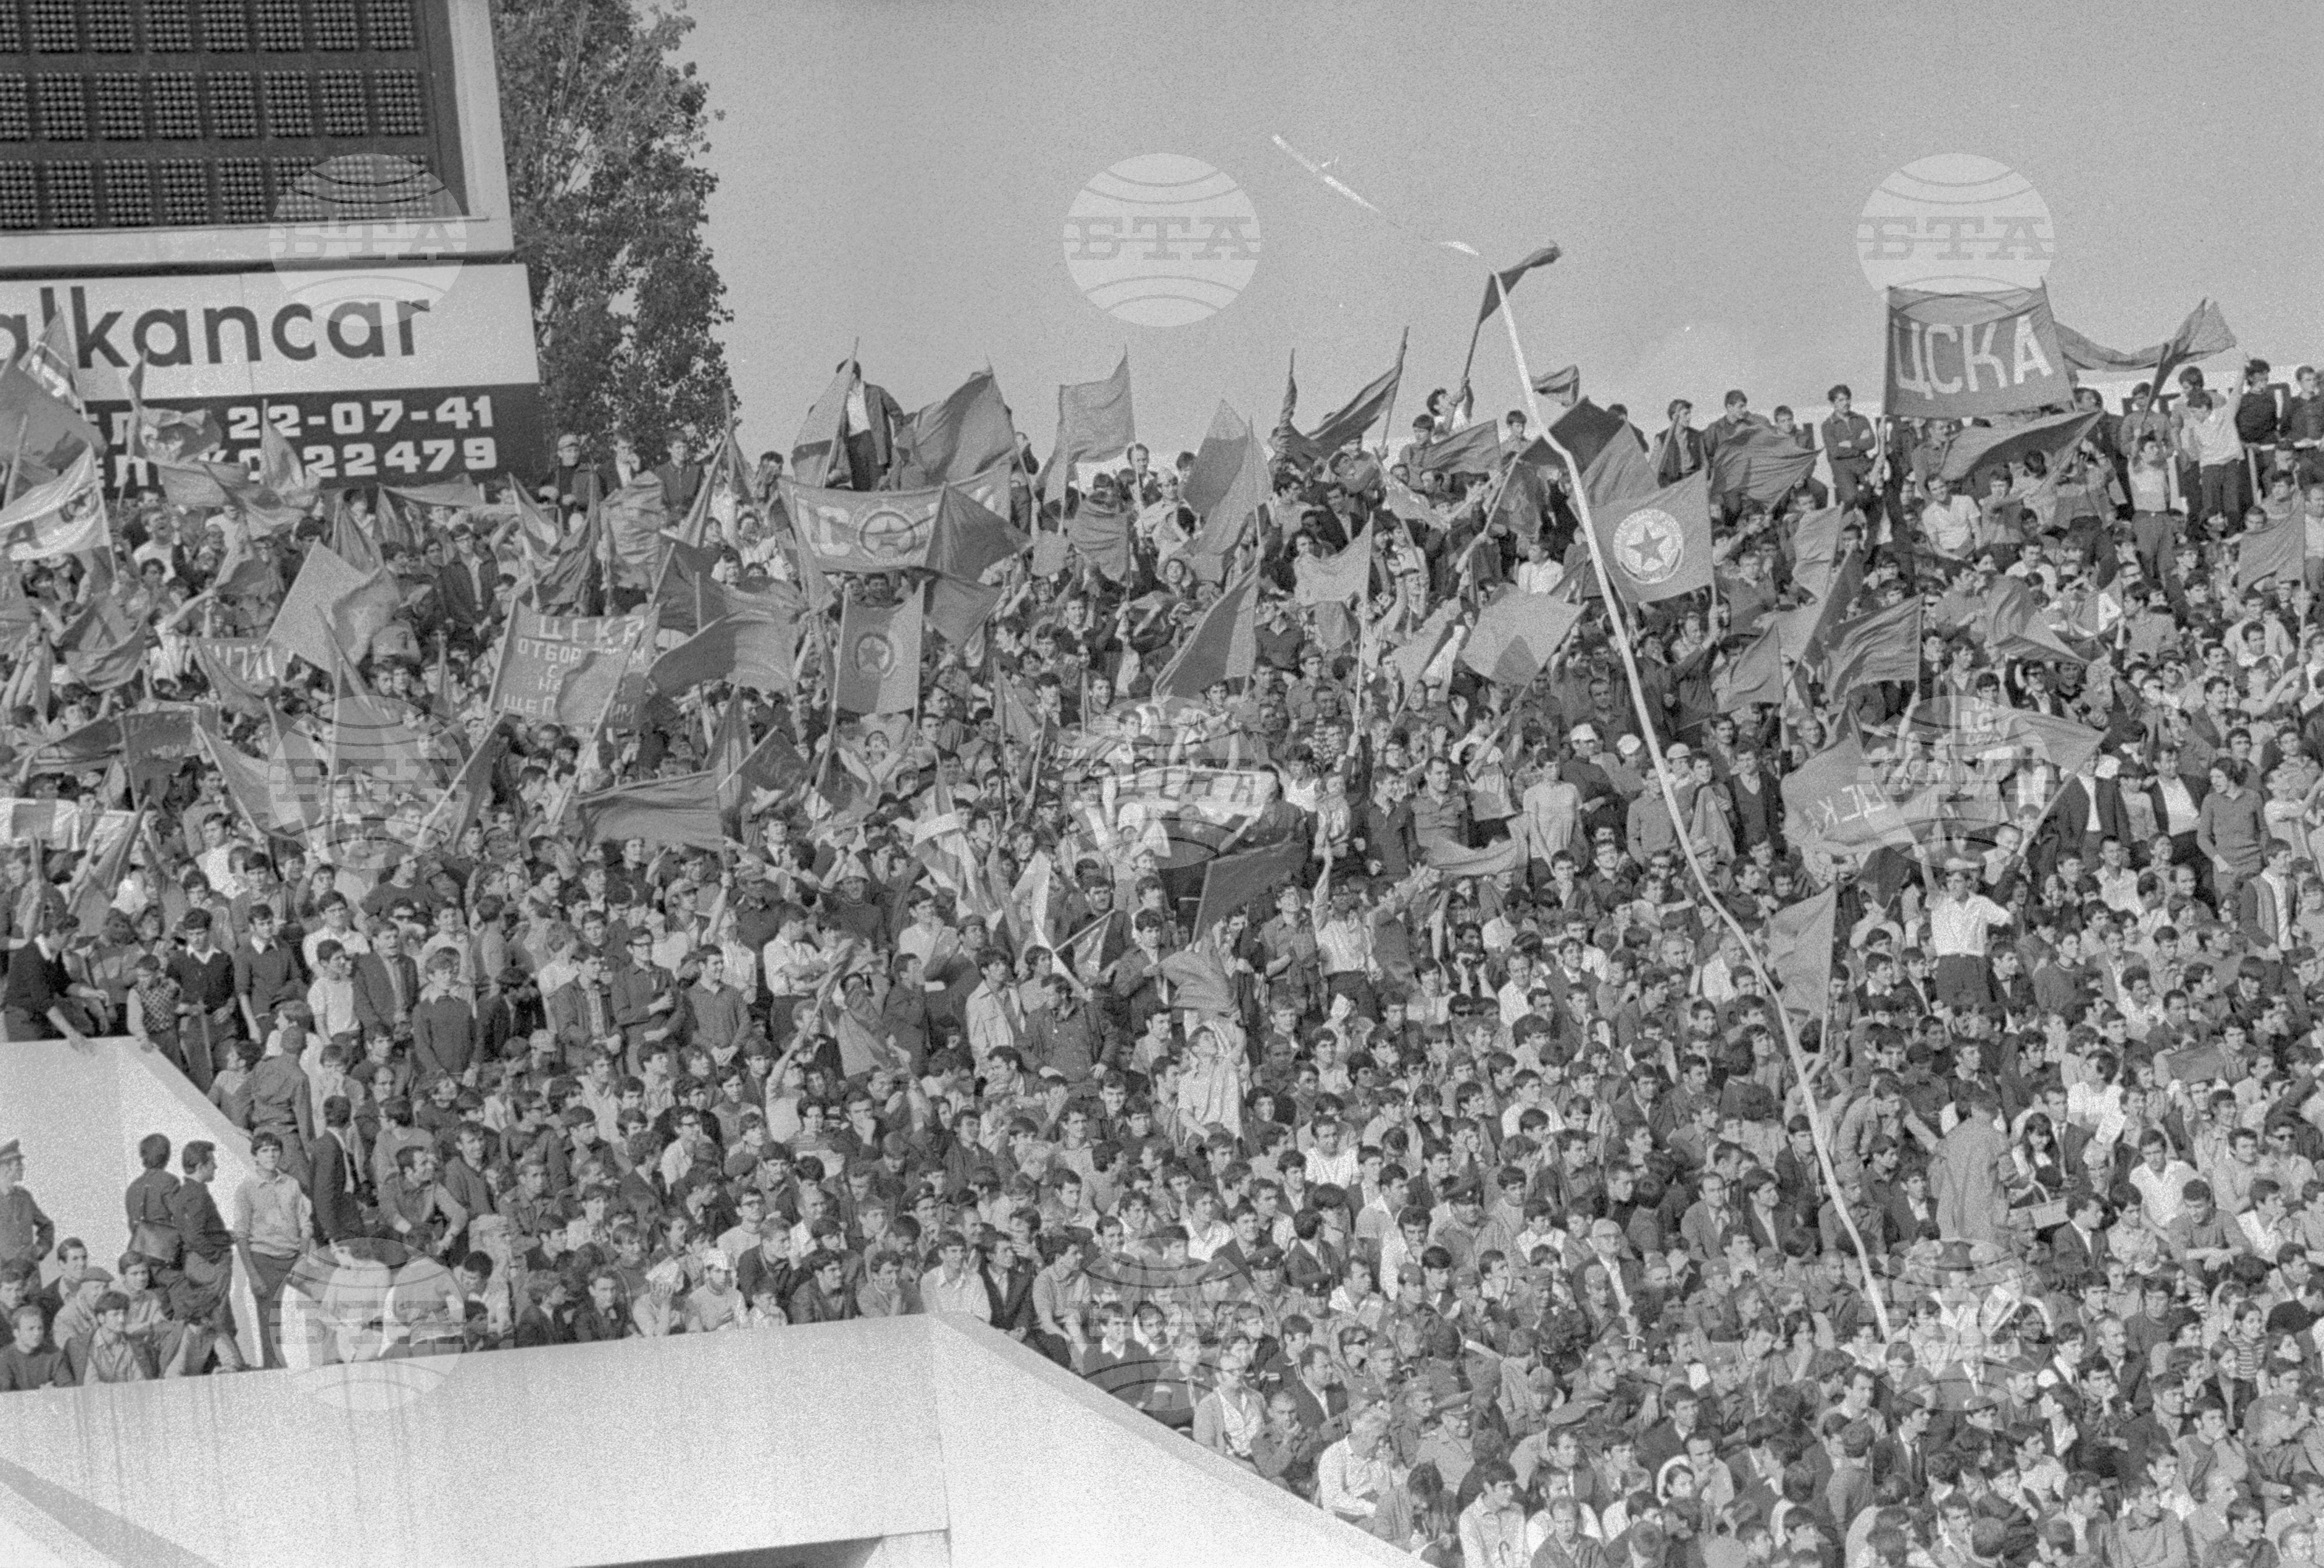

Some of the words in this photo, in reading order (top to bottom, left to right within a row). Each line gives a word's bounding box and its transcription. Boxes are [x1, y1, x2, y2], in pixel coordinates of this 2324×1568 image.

[1892, 315, 2054, 400] ЦСКА
[228, 395, 493, 439] 22-07-41
[303, 437, 497, 478] 22479
